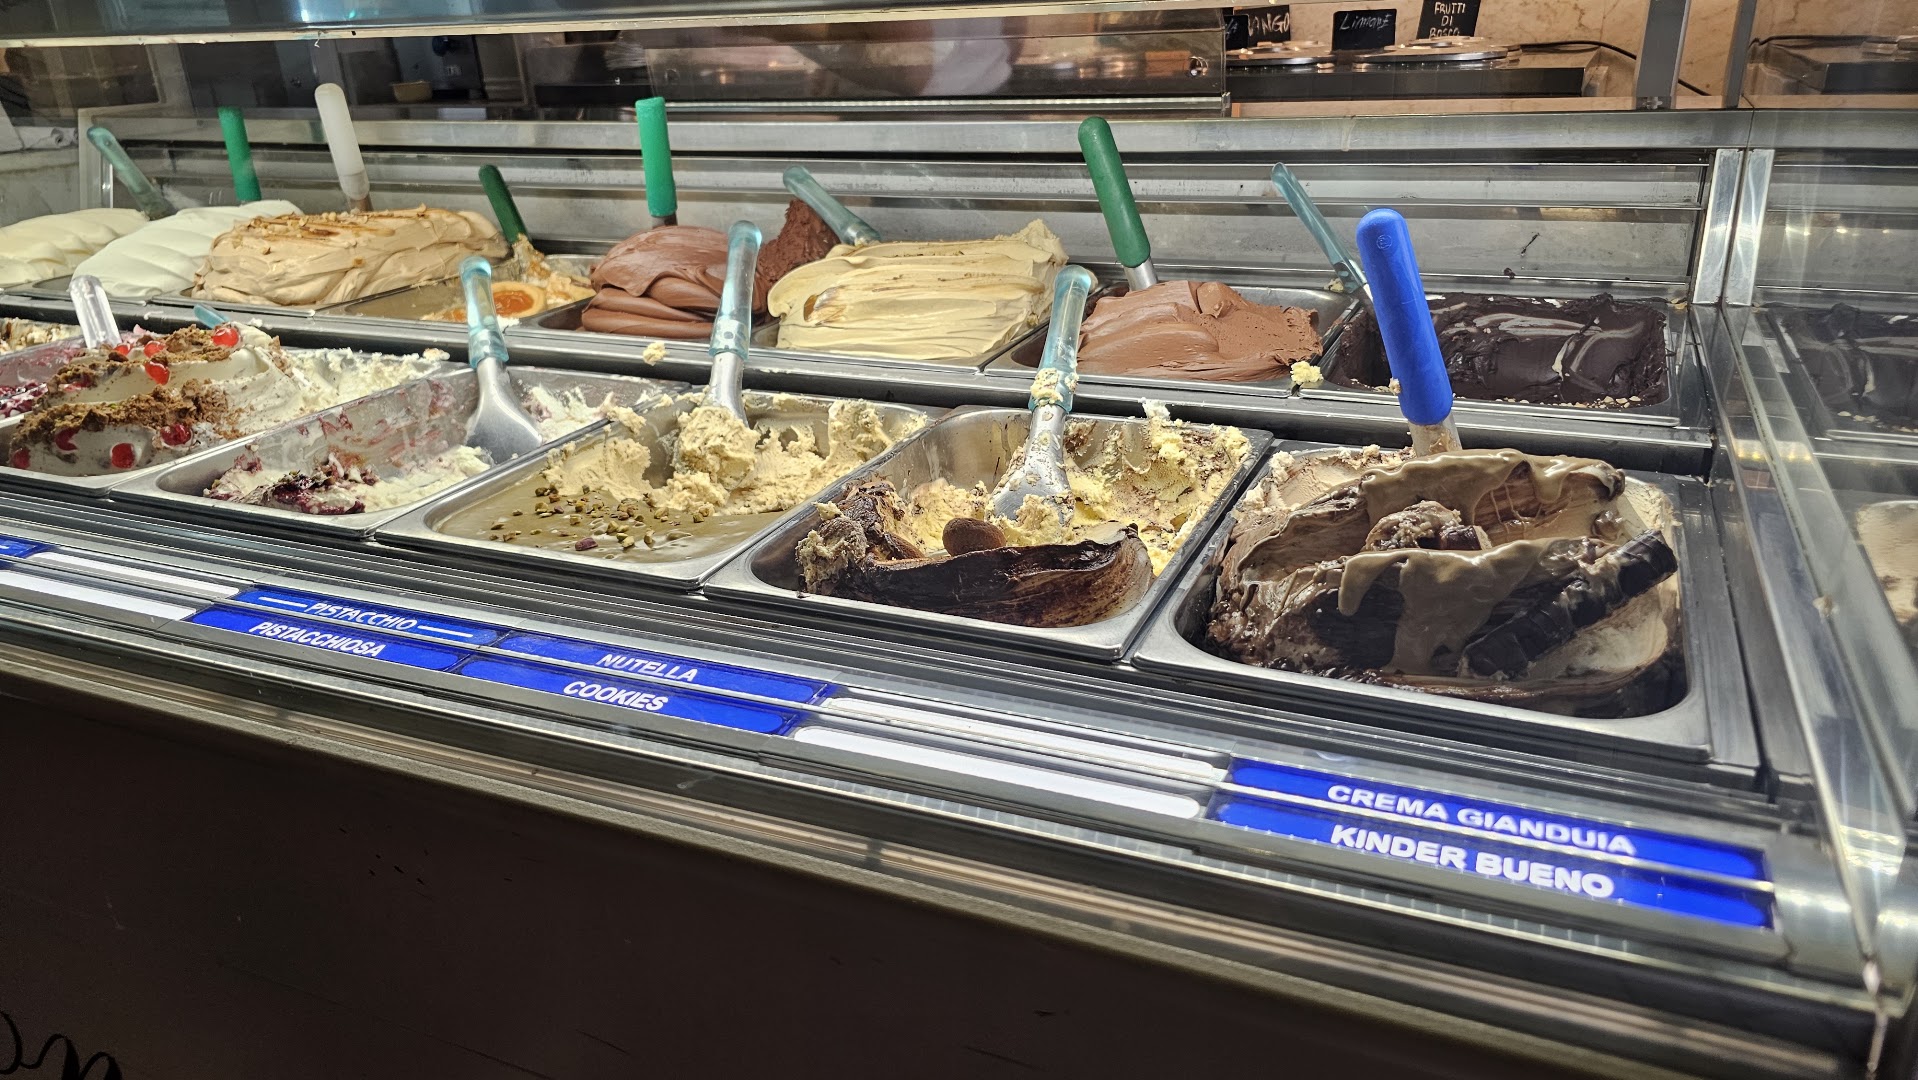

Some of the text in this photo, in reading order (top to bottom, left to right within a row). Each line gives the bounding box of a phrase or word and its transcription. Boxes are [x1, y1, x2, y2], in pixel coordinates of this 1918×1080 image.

[1434, 2, 1465, 14] FRUTTI
[1441, 15, 1453, 26] DI
[309, 603, 418, 631] PISTACCHIO
[249, 621, 387, 657] PISTACCHIOSA
[595, 653, 698, 682] NUTELLA
[563, 681, 669, 711] COOKIES
[1327, 784, 1636, 856] CREMA GIANDUIA
[1330, 824, 1615, 899] KINDER BUENO
